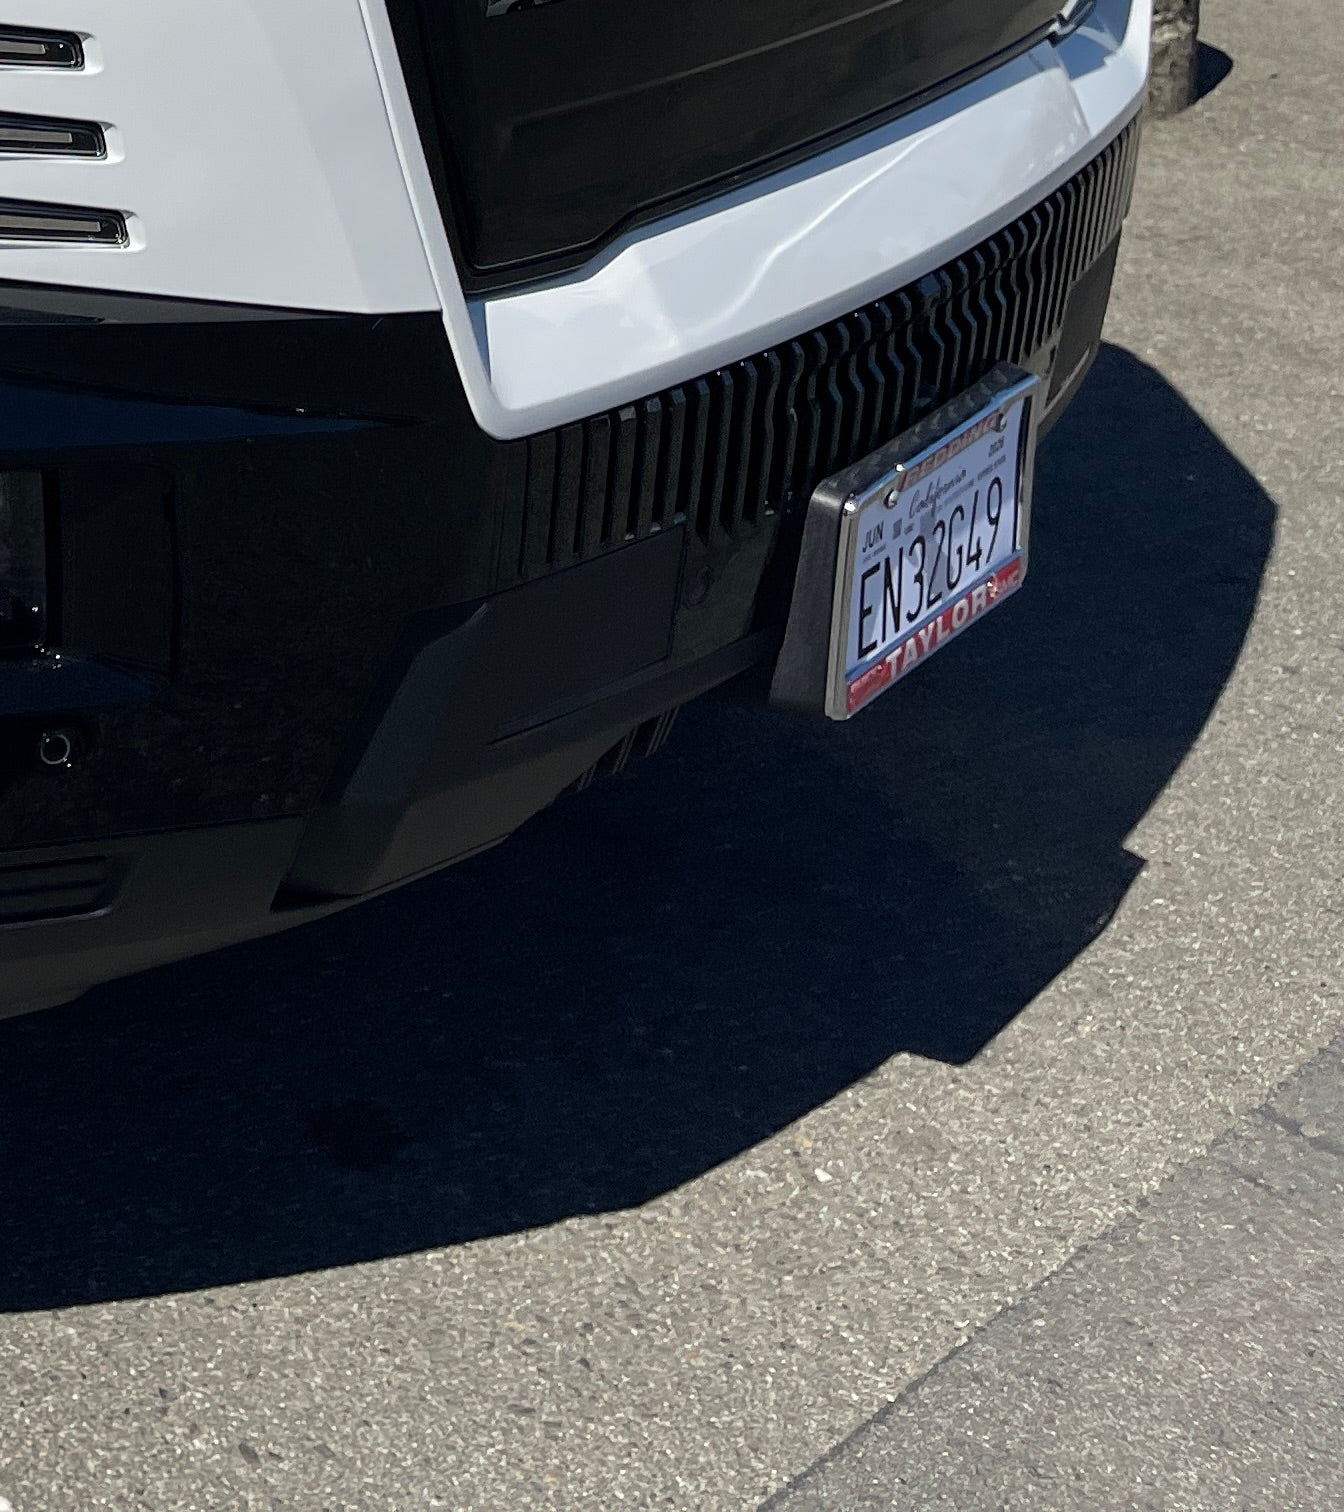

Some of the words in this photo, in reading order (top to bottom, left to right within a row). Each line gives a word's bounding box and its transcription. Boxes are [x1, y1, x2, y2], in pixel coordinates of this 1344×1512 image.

[858, 476, 1003, 660] EN32G49
[862, 520, 884, 553] JUN
[885, 583, 988, 679] TAYLOR
